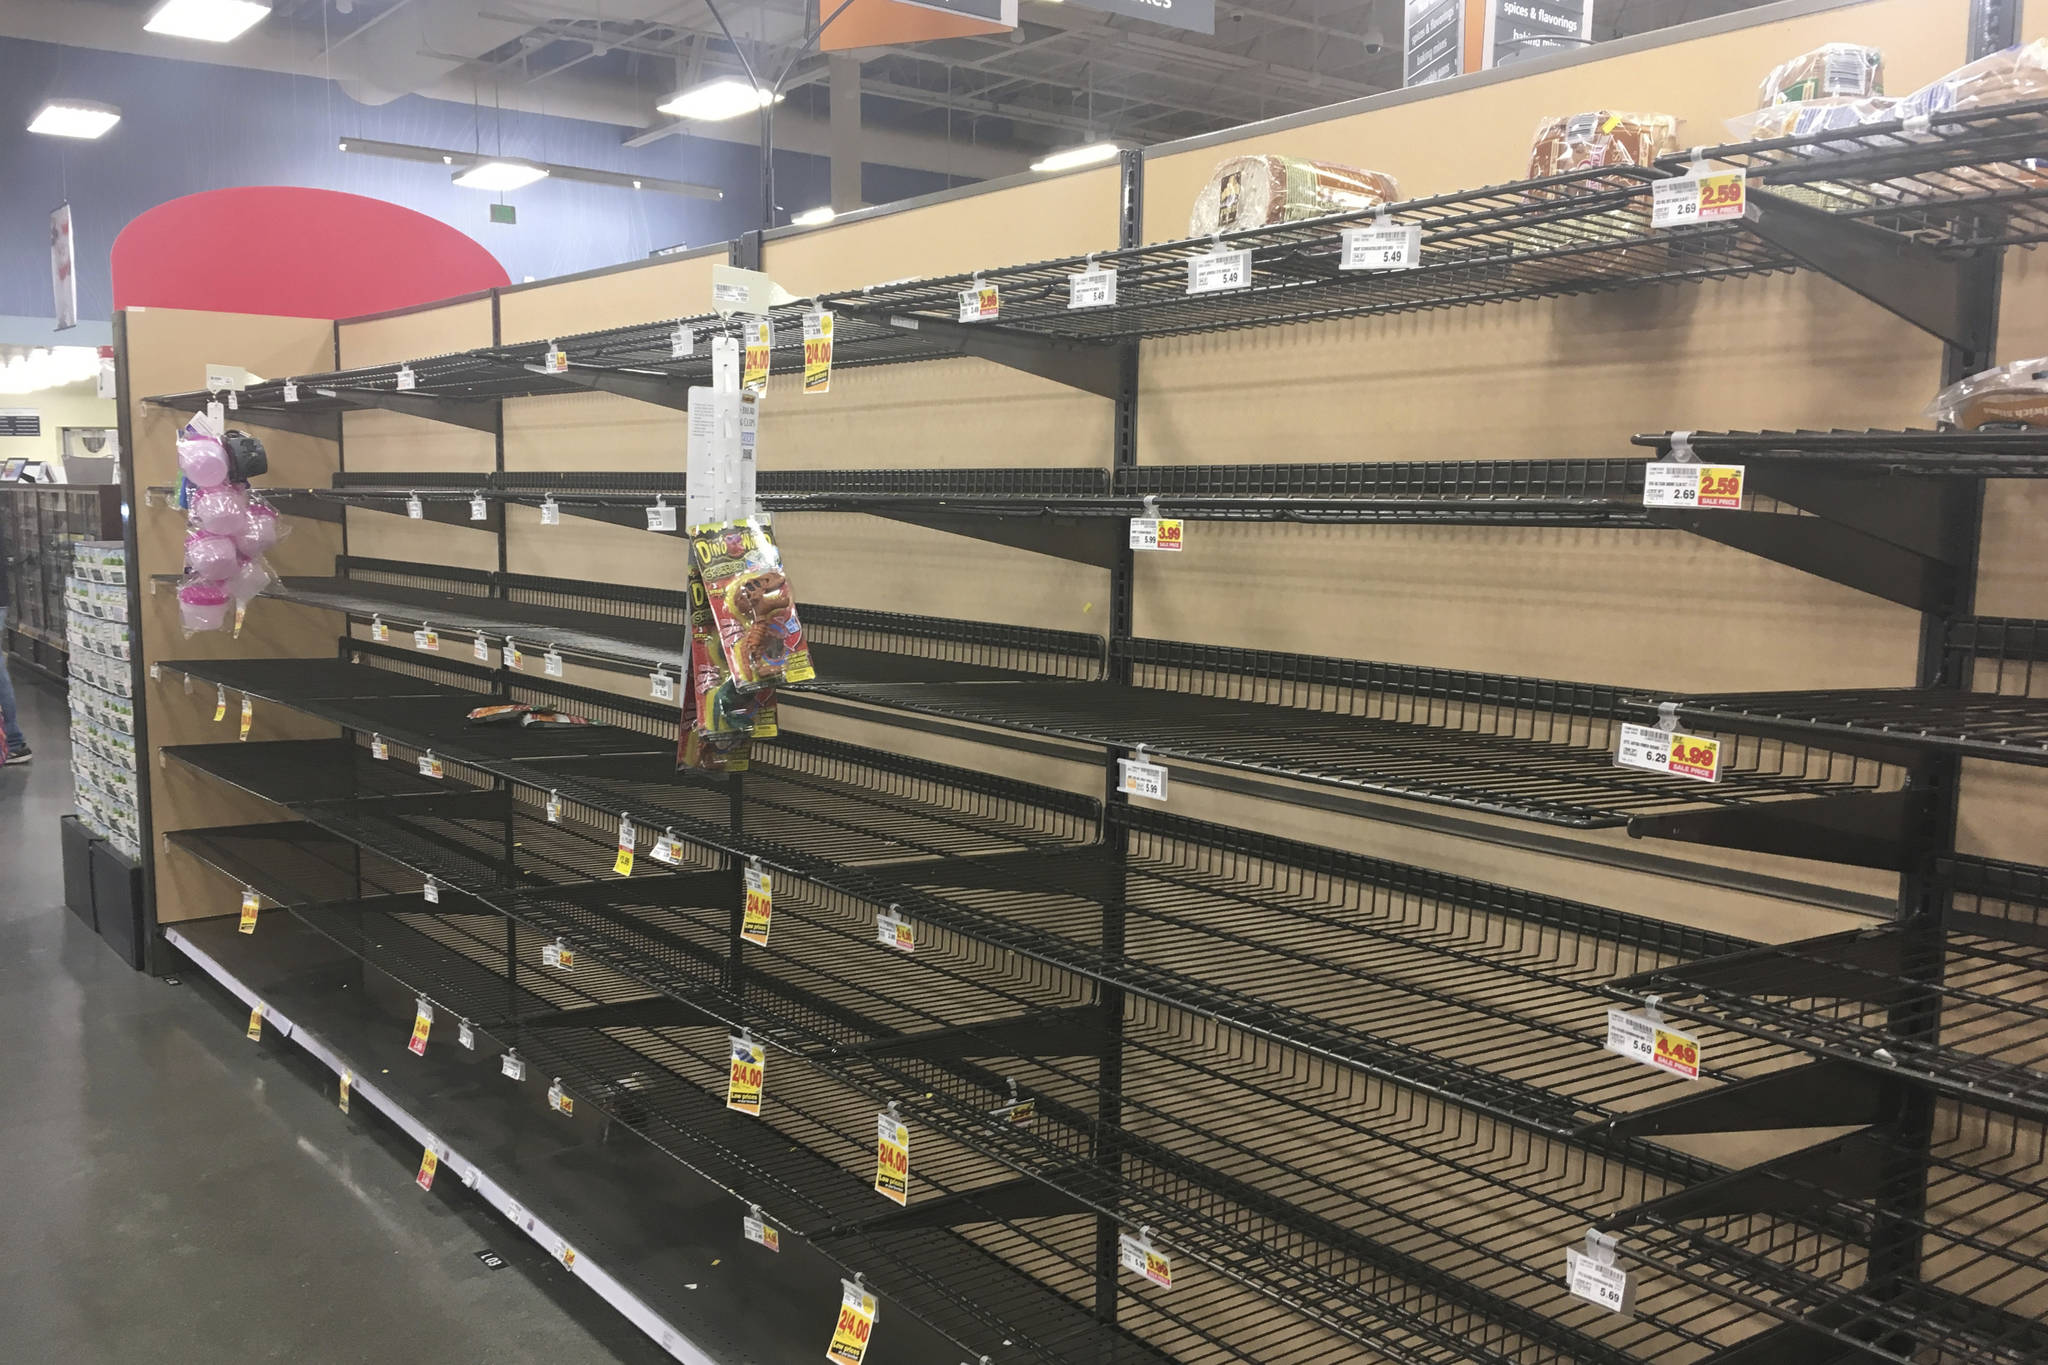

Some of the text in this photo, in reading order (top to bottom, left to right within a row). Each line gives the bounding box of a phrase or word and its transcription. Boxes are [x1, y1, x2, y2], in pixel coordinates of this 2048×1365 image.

[1504, 2, 1578, 32] spices & flavorings
[1702, 184, 1741, 205] 2.59
[1677, 203, 1696, 214] 2.69
[1383, 251, 1402, 262] 5.49
[1223, 272, 1238, 283] 5.49
[746, 350, 769, 370] 2/4.00
[806, 343, 831, 364] 2/4.00
[1674, 489, 1695, 500] 2.69
[1701, 476, 1739, 496] 2.59
[1718, 498, 1737, 506] PRICE
[1158, 527, 1180, 540] 3.99
[1646, 752, 1667, 763] 6.29
[1672, 744, 1714, 766] 4.99
[1673, 764, 1710, 777] SALE PRICE
[748, 894, 770, 919] 2/4.00
[1633, 1040, 1652, 1054] 5.69
[1658, 1038, 1696, 1064] 4.49
[732, 1064, 762, 1088] 2/4.00
[880, 1144, 907, 1175] 2/4.00
[1600, 1288, 1620, 1302] 5.69
[838, 1310, 870, 1343] 2/4.00
